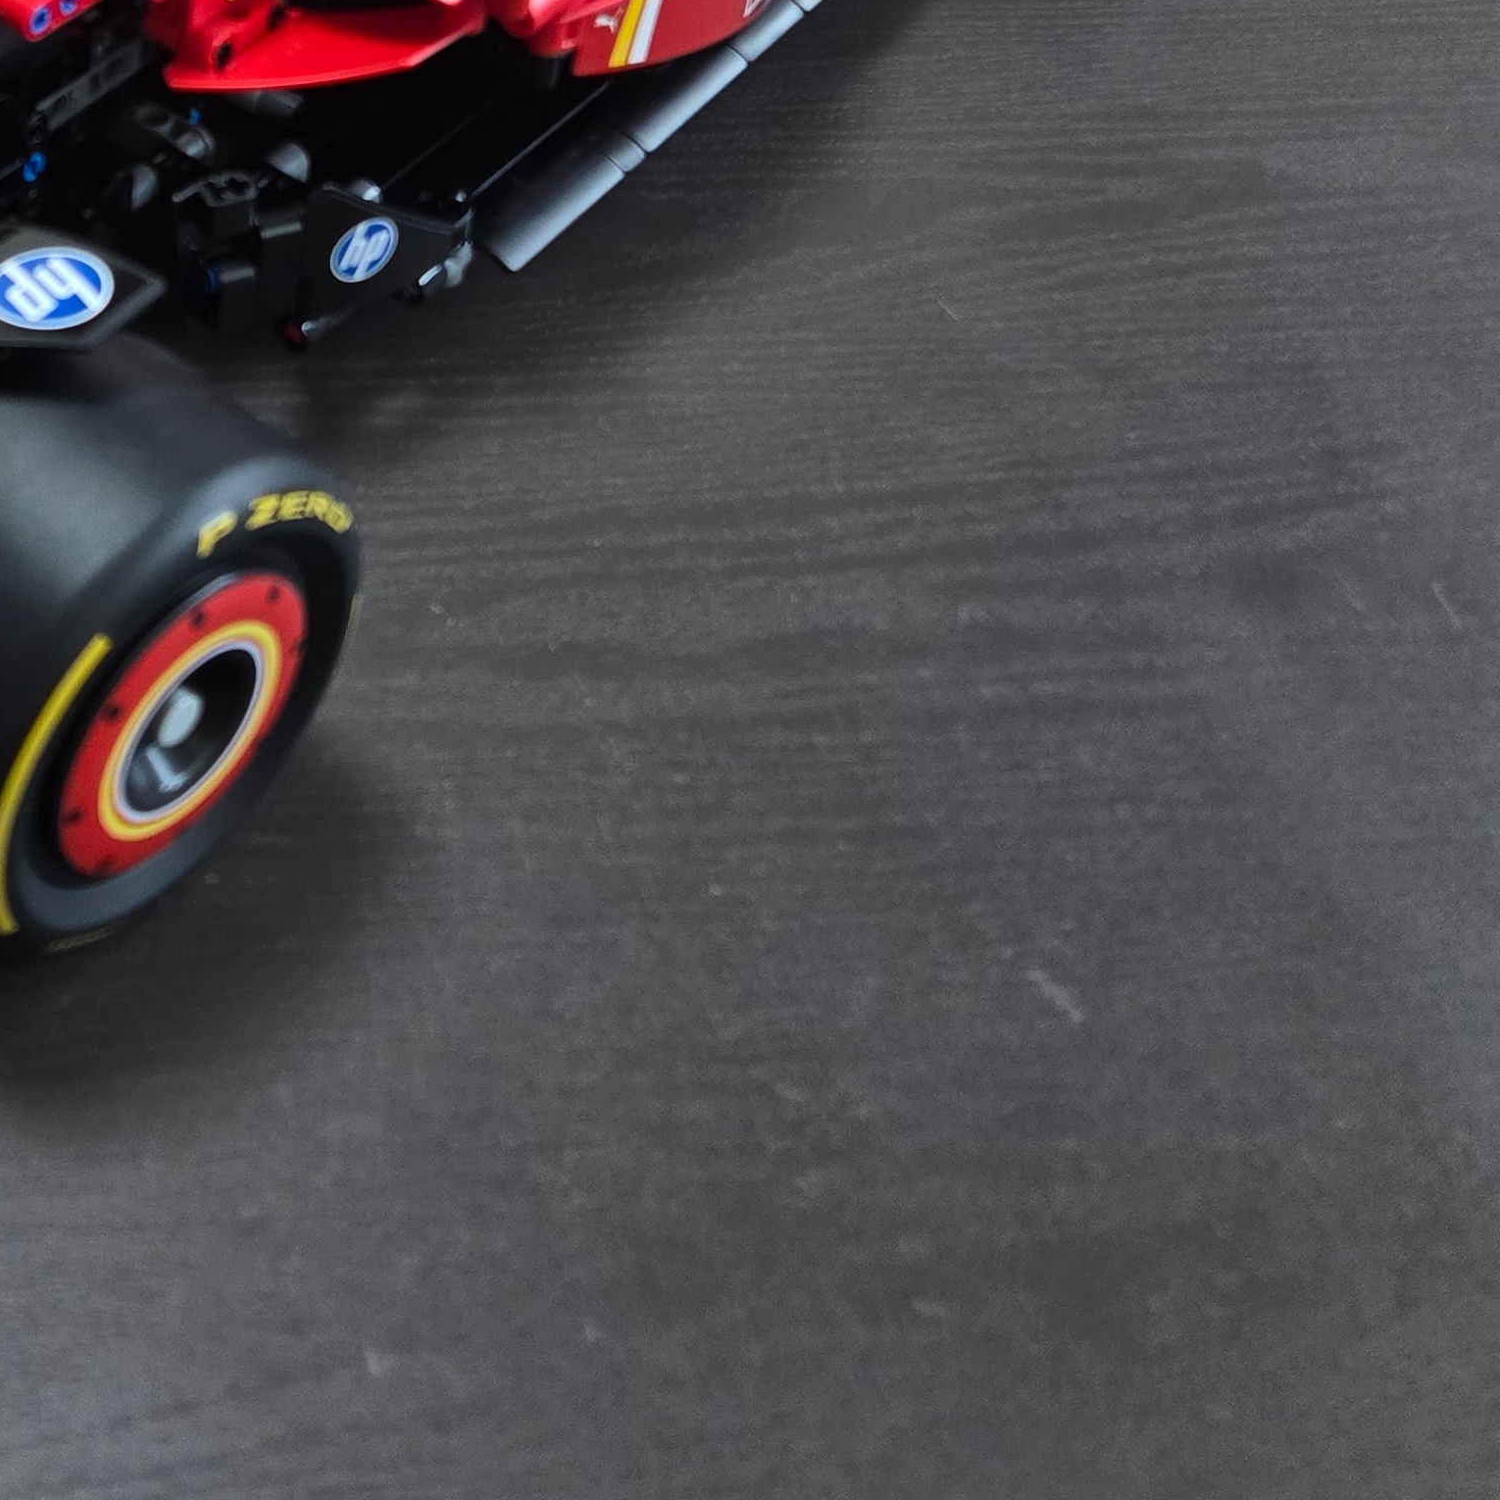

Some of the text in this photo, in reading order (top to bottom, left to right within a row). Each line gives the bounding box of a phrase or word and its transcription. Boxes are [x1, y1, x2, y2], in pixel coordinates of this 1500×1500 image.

[336, 221, 394, 279] hp
[197, 489, 355, 560] P ZERO
